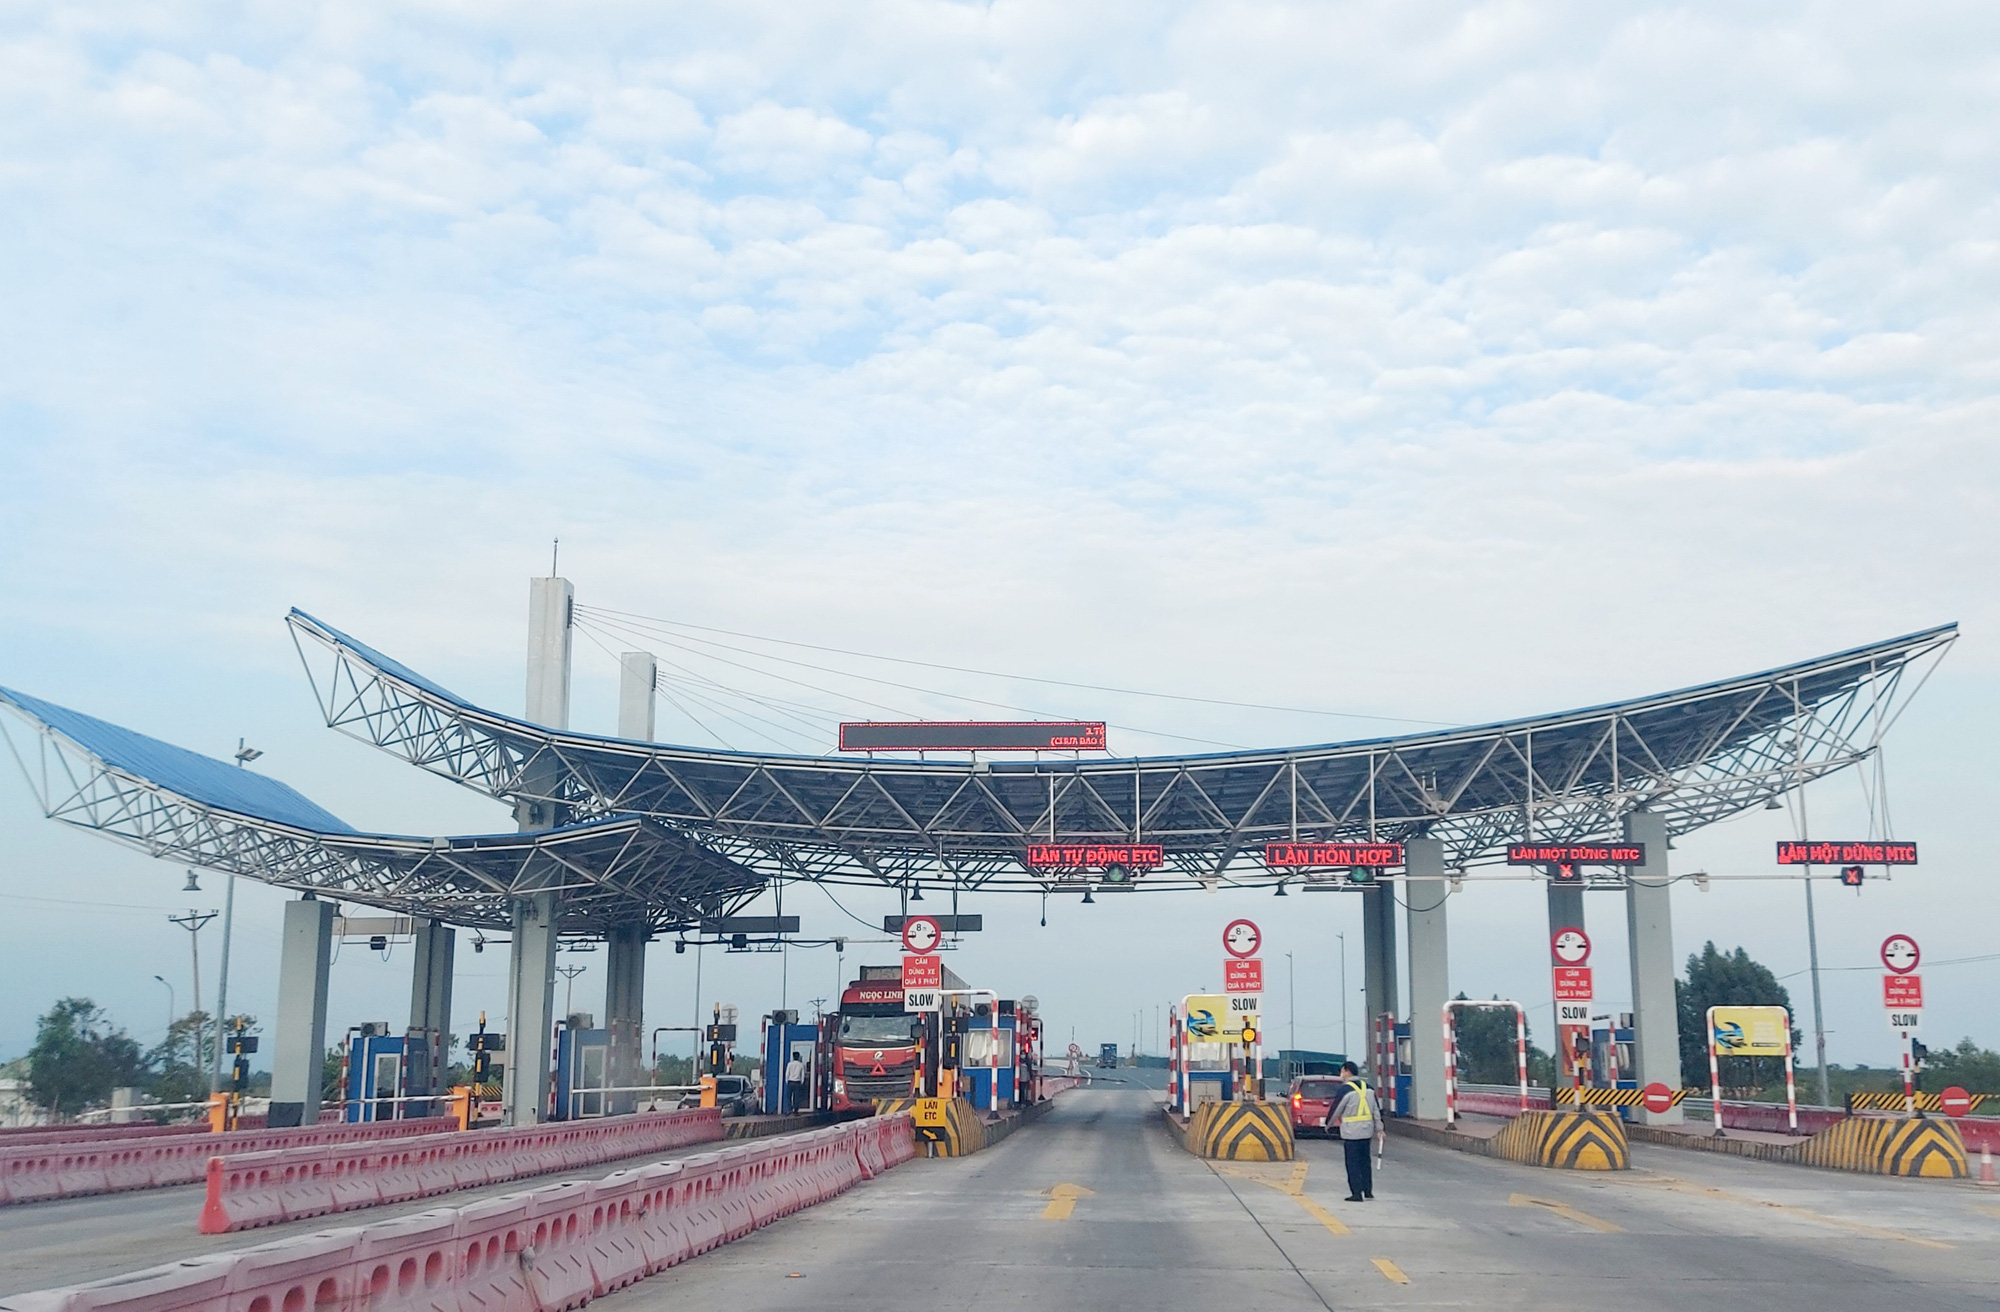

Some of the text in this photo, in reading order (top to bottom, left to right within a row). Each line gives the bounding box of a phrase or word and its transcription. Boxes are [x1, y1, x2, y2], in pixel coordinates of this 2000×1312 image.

[1032, 846, 1159, 866] LÀN TỰ ĐỘNG ETC
[1274, 846, 1309, 863] LÀN
[1511, 846, 1640, 862] LÀN MỘT DỪNG MTC
[1779, 842, 1916, 864] LÀN MỘT DỪNG MTC
[860, 991, 903, 1001] NGỌC LINH
[908, 993, 934, 1007] SLOW
[1232, 998, 1257, 1011] SLOW
[1562, 1006, 1587, 1019] SLOW
[1892, 1014, 1918, 1027] SLOW
[924, 1099, 938, 1110] LÀN
[924, 1111, 937, 1120] ETC
